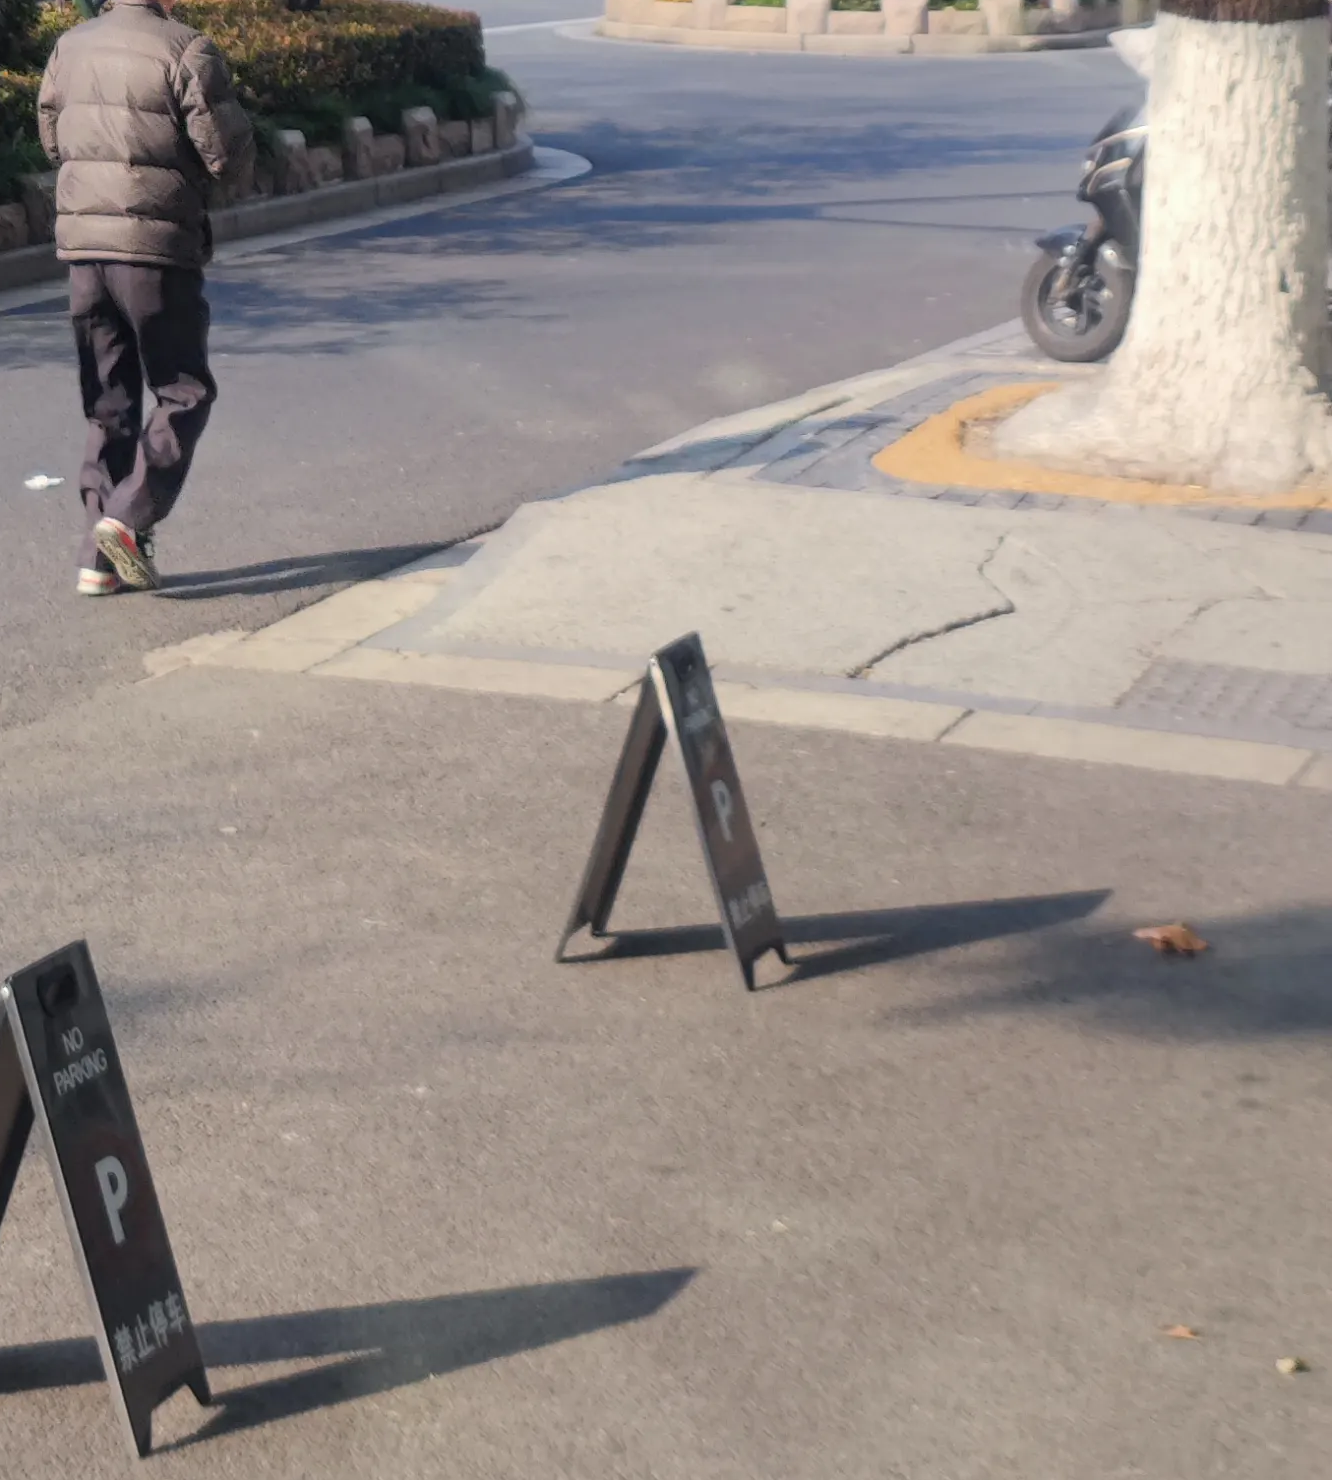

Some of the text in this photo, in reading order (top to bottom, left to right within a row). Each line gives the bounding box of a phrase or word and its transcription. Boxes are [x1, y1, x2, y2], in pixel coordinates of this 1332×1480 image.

[710, 779, 733, 842] P
[53, 1047, 108, 1096] PARKING
[61, 1026, 84, 1056] NO
[95, 1155, 128, 1244] P
[114, 1290, 186, 1374] 禁止停车
